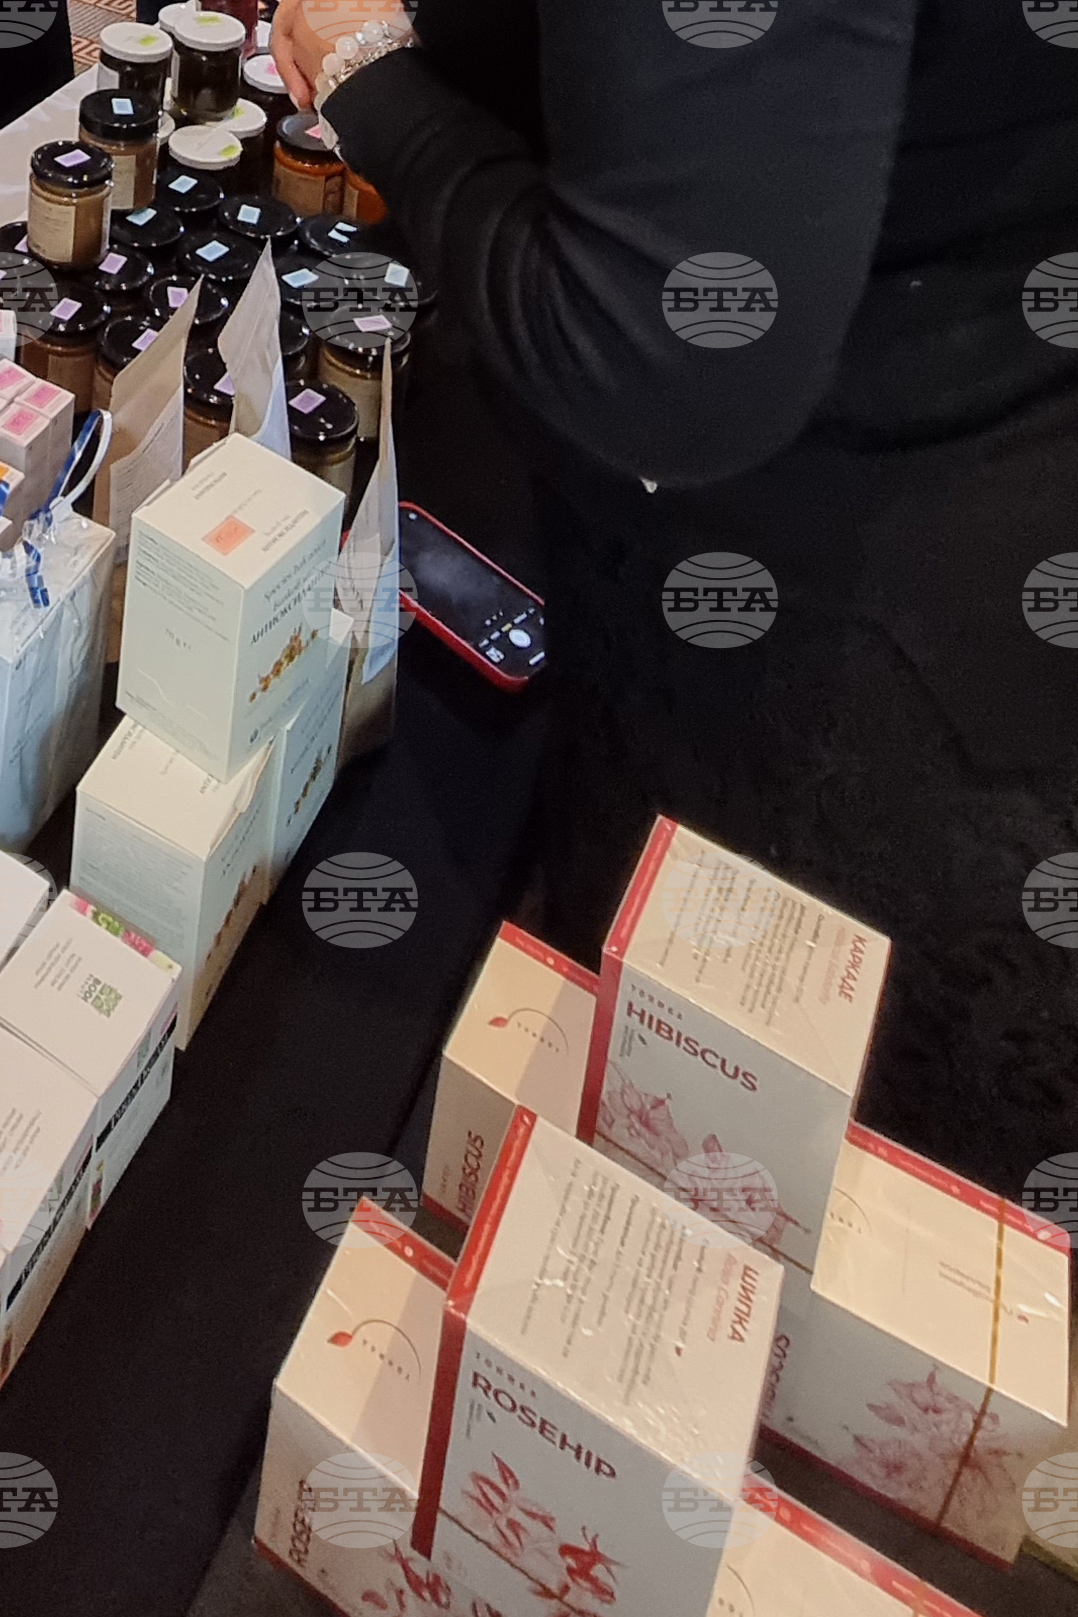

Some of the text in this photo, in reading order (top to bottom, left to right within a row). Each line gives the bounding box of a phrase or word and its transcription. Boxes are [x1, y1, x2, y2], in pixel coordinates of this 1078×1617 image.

[80, 976, 102, 1003] BODI
[836, 934, 868, 1004] КАРКАДЕ
[626, 1001, 760, 1094] HIBISCUS
[456, 1131, 486, 1217] HIBISCUS
[730, 1263, 765, 1344] ШИПКА
[469, 1371, 618, 1482] ROSEHIP
